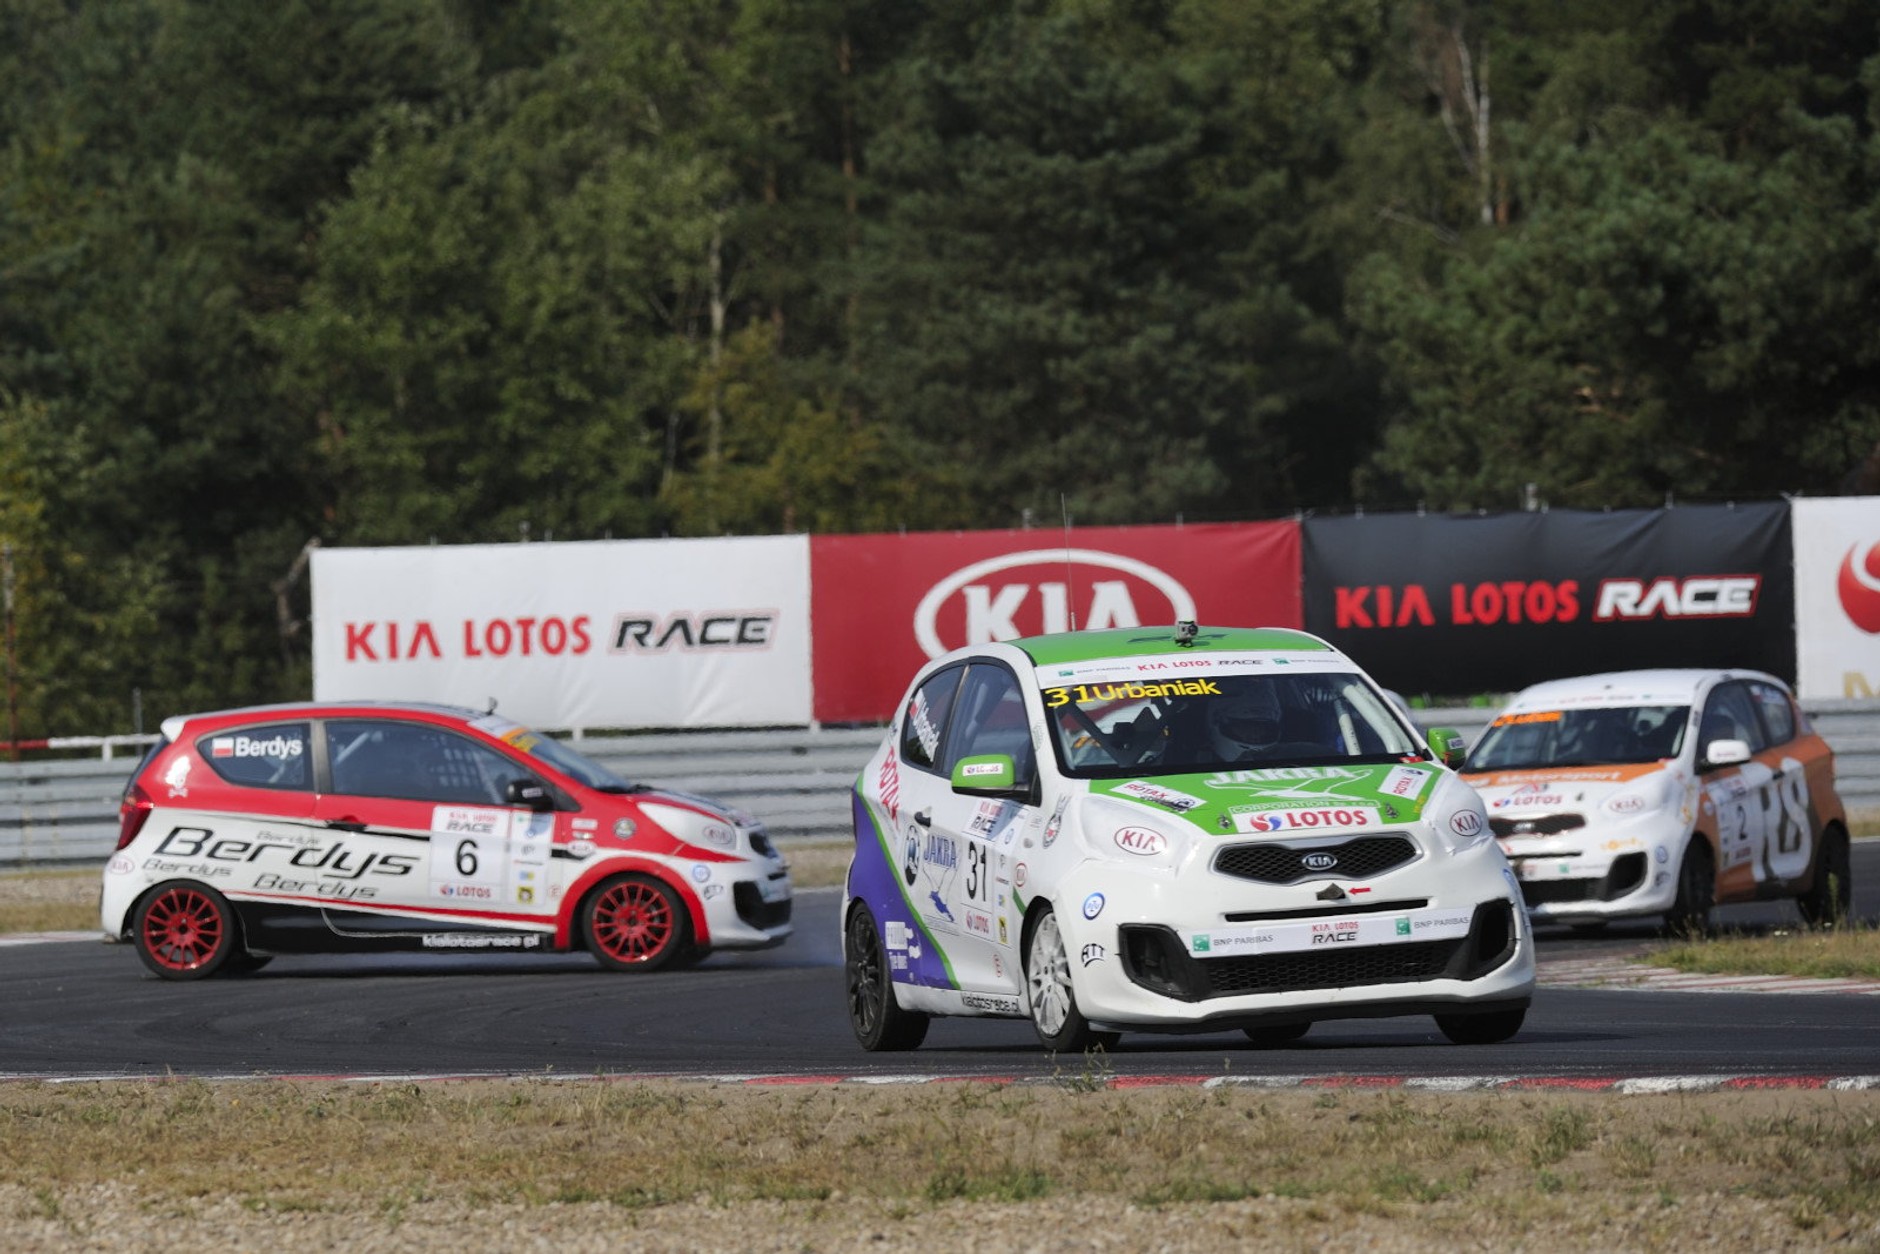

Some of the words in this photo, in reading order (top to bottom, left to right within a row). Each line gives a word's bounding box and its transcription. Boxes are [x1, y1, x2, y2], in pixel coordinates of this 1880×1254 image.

[1335, 585, 1435, 628] KIA
[1450, 580, 1579, 625] LOTOS
[1599, 575, 1759, 619] RACE
[962, 580, 1141, 646] KIA
[345, 622, 442, 661] KIA
[464, 615, 592, 657] LOTOS
[613, 615, 774, 650] RACE
[1137, 663, 1168, 671] KIA
[1173, 660, 1212, 668] LOTOS
[235, 735, 303, 760] Berdys
[1232, 801, 1329, 814] CORPORATION
[1514, 795, 1562, 806] LOTOS
[446, 821, 493, 834] RACE
[1285, 810, 1368, 828] LOTOS
[1453, 814, 1480, 832] KIA
[1736, 805, 1748, 841] 2
[1121, 830, 1155, 851] KIA
[153, 827, 421, 879] Berdys
[456, 839, 478, 876] 6
[1308, 855, 1333, 866] KIA
[142, 858, 234, 878] Berdys
[966, 841, 987, 902] 31
[253, 872, 379, 900] Berdys
[456, 886, 491, 898] LOTOS
[1312, 923, 1330, 932] KIA
[1335, 921, 1359, 931] LOTOS
[1413, 920, 1433, 929] BNP
[1213, 937, 1233, 946] BNP
[1234, 934, 1274, 945] PARIBAS
[1312, 932, 1357, 945] RACE
